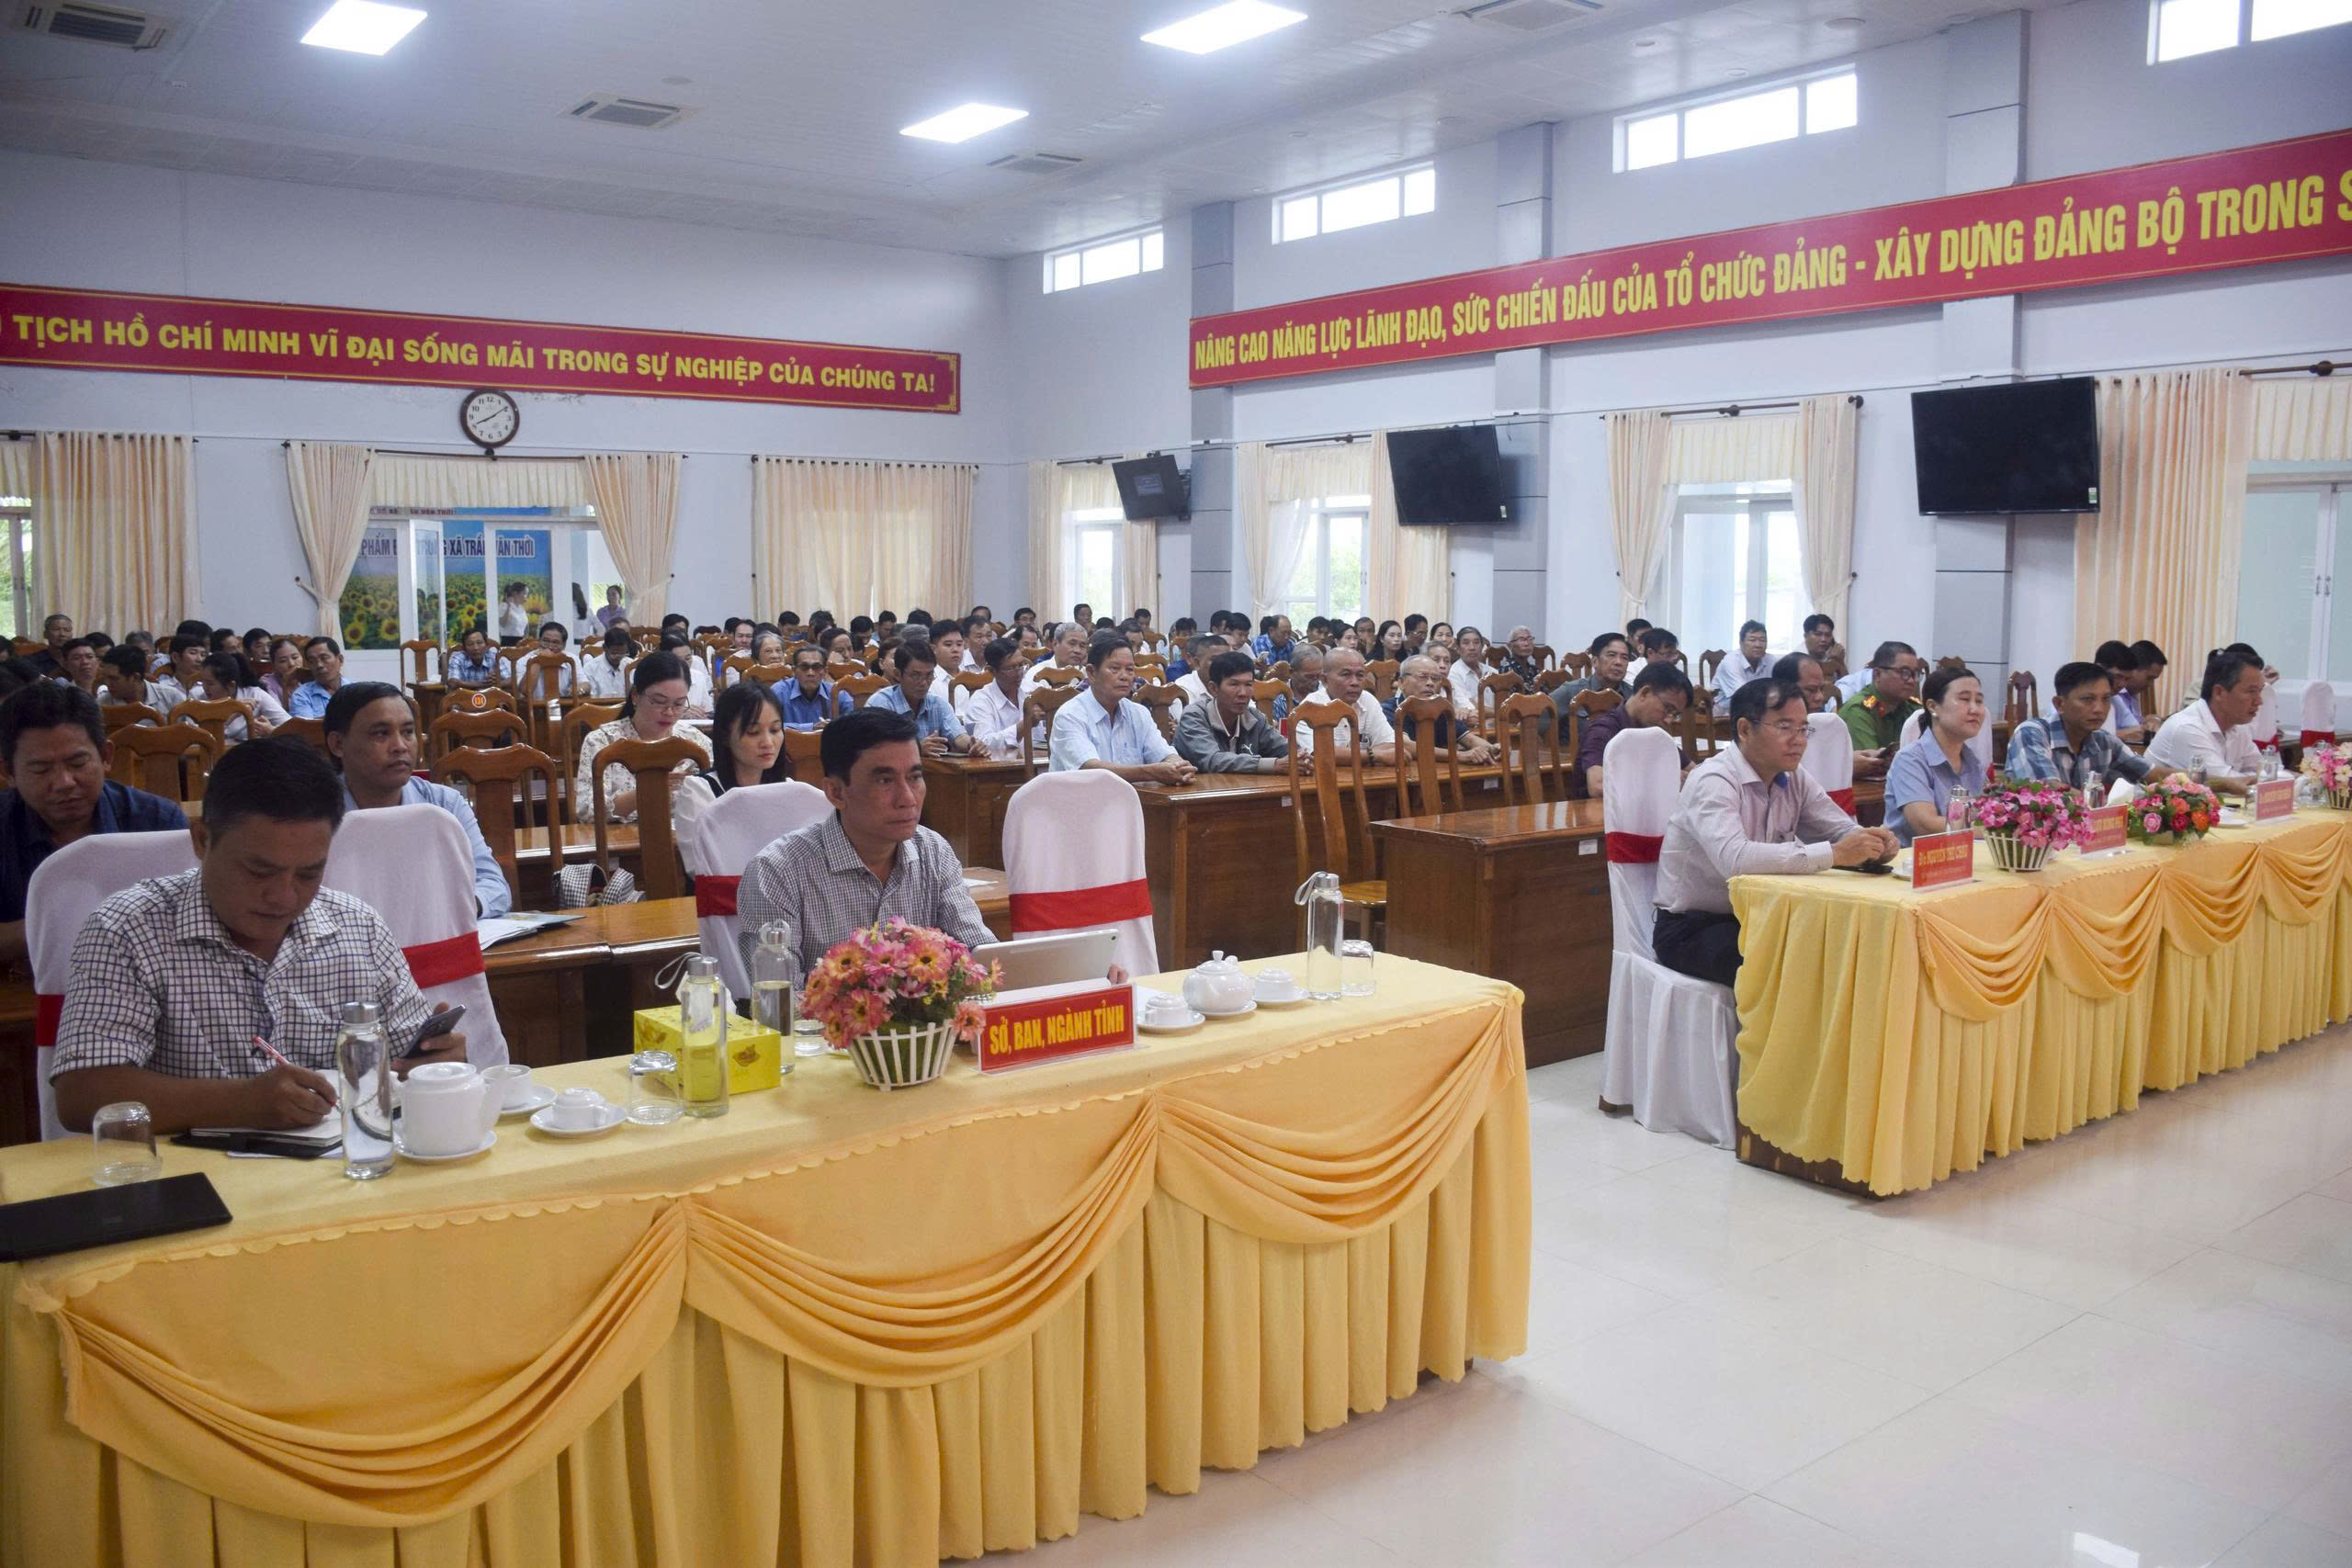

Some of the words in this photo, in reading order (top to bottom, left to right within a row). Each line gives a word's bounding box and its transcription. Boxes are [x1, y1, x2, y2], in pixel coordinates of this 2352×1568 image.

[1195, 333, 1235, 369] NÂNG
[1238, 332, 1268, 364] CAO
[1272, 321, 1317, 359] NĂNG
[1320, 317, 1351, 358] LỰC
[1356, 309, 1401, 349] LÃNH
[1406, 305, 1446, 349] ĐẠO,
[1453, 292, 1490, 335] SỨC
[1496, 277, 1557, 330] CHIẾN
[1563, 268, 1606, 321] ĐẤU
[1612, 262, 1657, 315] CỦA
[1665, 251, 1693, 308] TỔ
[1701, 251, 1766, 302] CHỨC
[1774, 236, 1847, 294] ĐẢNG
[1874, 227, 1930, 281] XÂY
[1939, 220, 2024, 279] DỰNG
[2033, 196, 2126, 261] ĐẢNG
[2137, 186, 2185, 255] BỘ
[2197, 175, 2323, 240] TRONG
[13, 315, 92, 348] TỊCH
[104, 312, 149, 347] HỒ
[159, 321, 213, 351] CHÍ
[223, 328, 300, 355] MINH
[309, 329, 339, 357] VĨ
[345, 336, 394, 366] ĐẠI
[404, 332, 478, 366] SỐNG
[487, 341, 534, 368] MÃI
[543, 348, 628, 374] TRONG
[636, 352, 670, 382] SỰ
[675, 355, 763, 387] NGHIỆP
[769, 357, 815, 386] CỦA
[820, 363, 896, 391] CHÚNG
[901, 371, 936, 392] TA!
[989, 1015, 1012, 1055] SỞ,
[1014, 1018, 1045, 1050] BAN,
[1047, 1007, 1092, 1044] NGÀNH
[1094, 999, 1124, 1036] TỈNH
